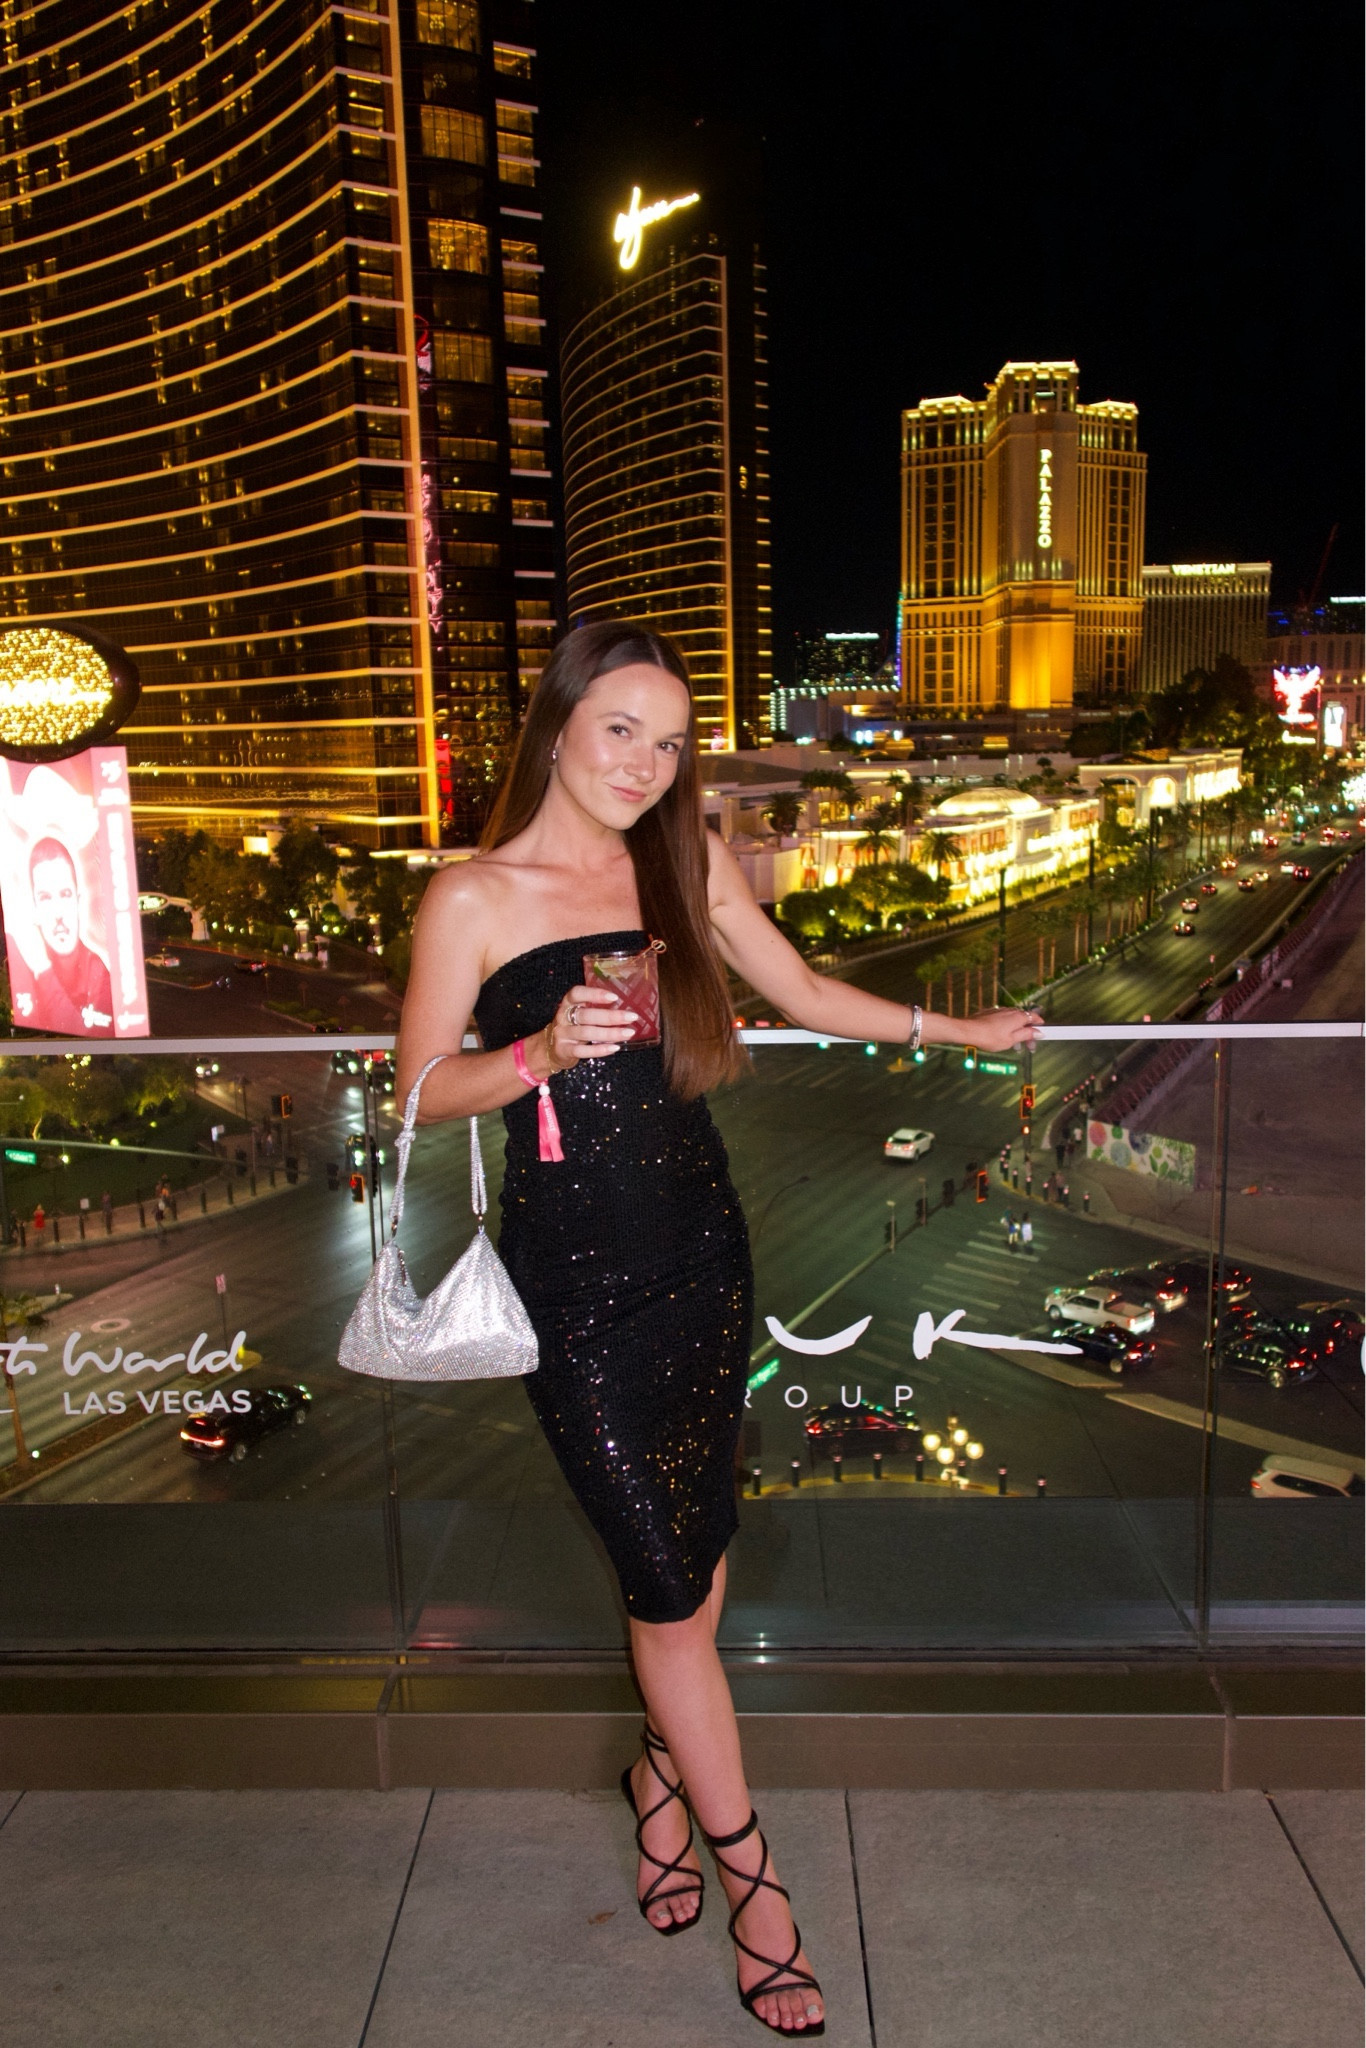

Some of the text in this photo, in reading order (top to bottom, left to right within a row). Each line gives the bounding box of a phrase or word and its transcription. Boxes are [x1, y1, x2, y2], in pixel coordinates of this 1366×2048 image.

[1038, 448, 1052, 549] PALAZZO
[63, 1390, 253, 1415] LAS VEGAS
